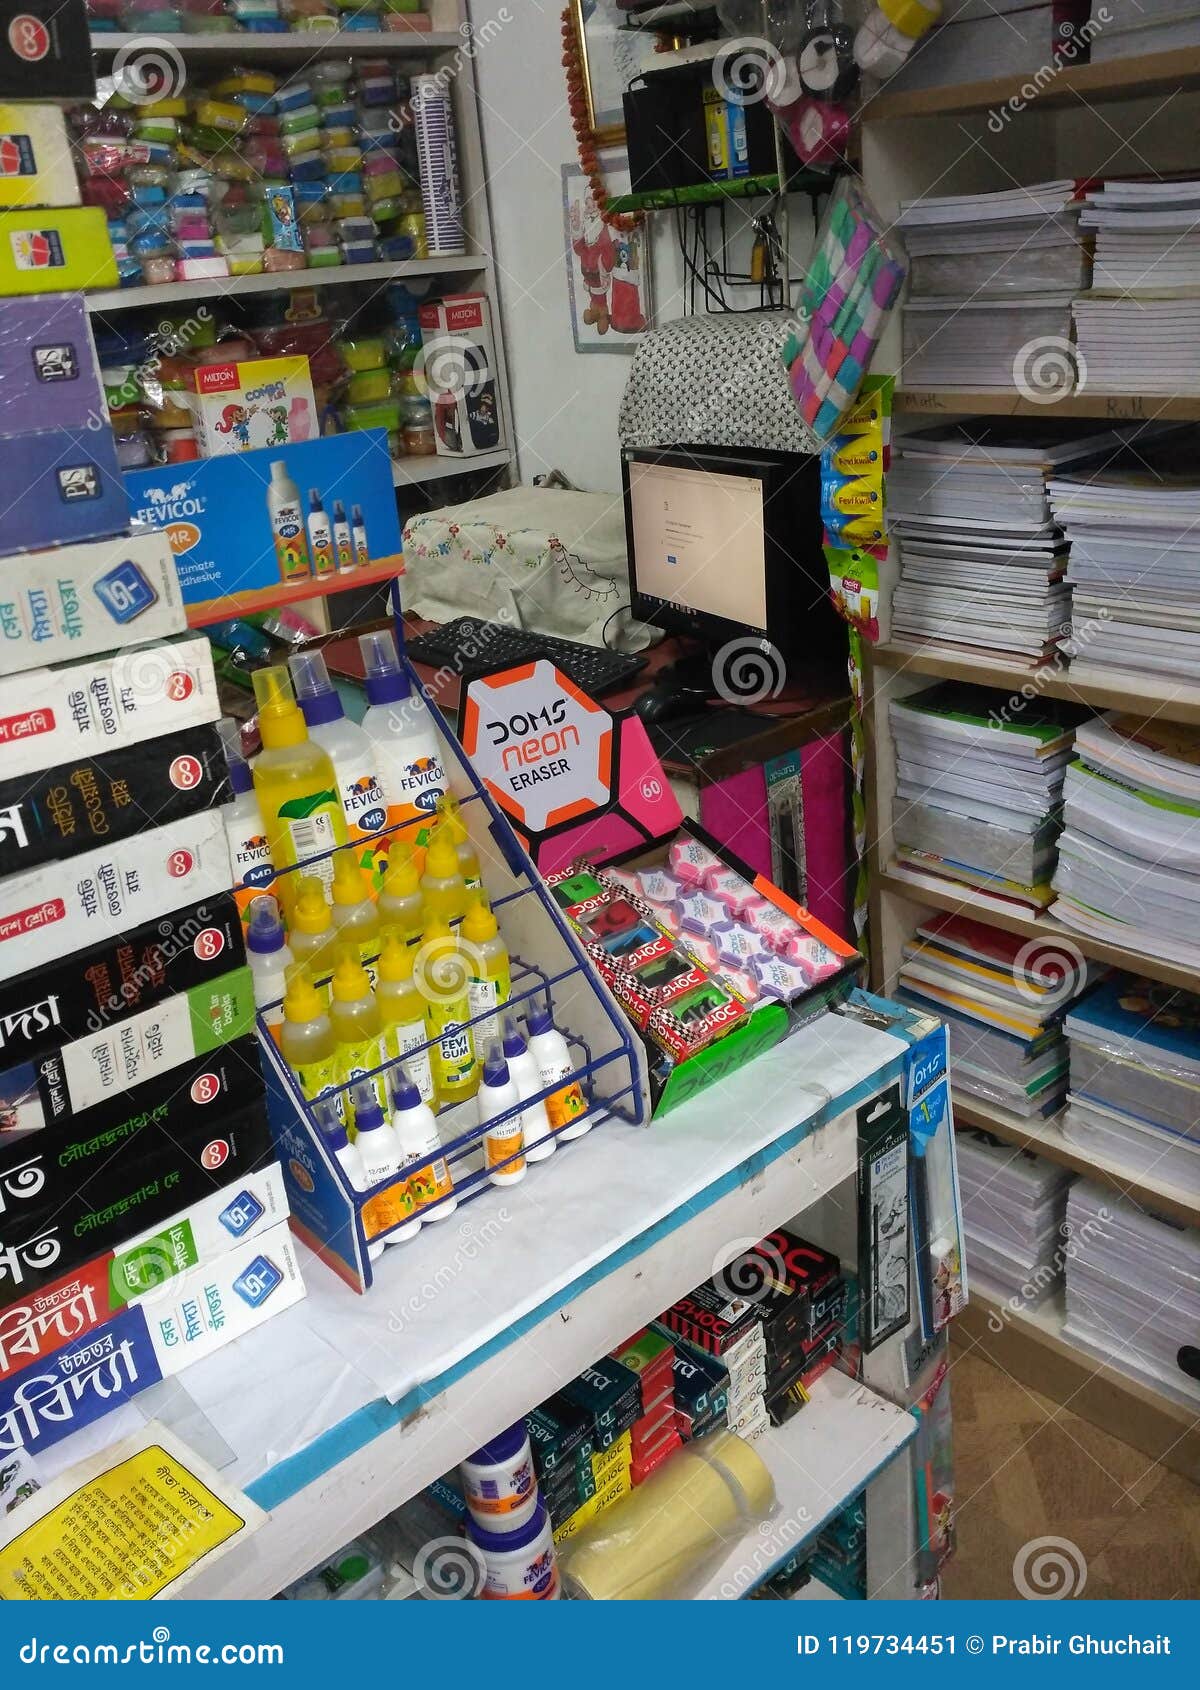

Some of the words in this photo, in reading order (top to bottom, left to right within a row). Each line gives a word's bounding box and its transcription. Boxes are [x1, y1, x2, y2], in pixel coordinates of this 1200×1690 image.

[450, 306, 477, 322] MILTON
[202, 369, 235, 386] MILTON
[137, 500, 206, 524] FEVICOL
[274, 514, 301, 525] FEVICOL
[177, 559, 216, 577] ltimate
[487, 699, 569, 746] DOMS
[501, 724, 580, 772] neon
[509, 758, 572, 793] ERASER
[642, 781, 661, 796] 60
[363, 815, 385, 829] MR
[577, 892, 611, 914] DOMS
[628, 940, 666, 966] DOMS
[663, 972, 701, 998] DOMS
[614, 983, 648, 1014] DOMS
[700, 1004, 738, 1034] DOMS
[441, 1033, 468, 1051] FEVI
[650, 1017, 685, 1051] DOMS
[441, 1046, 470, 1060] GUM
[58, 1333, 114, 1374] উচ্চতর
[155, 1465, 181, 1491] গীতা
